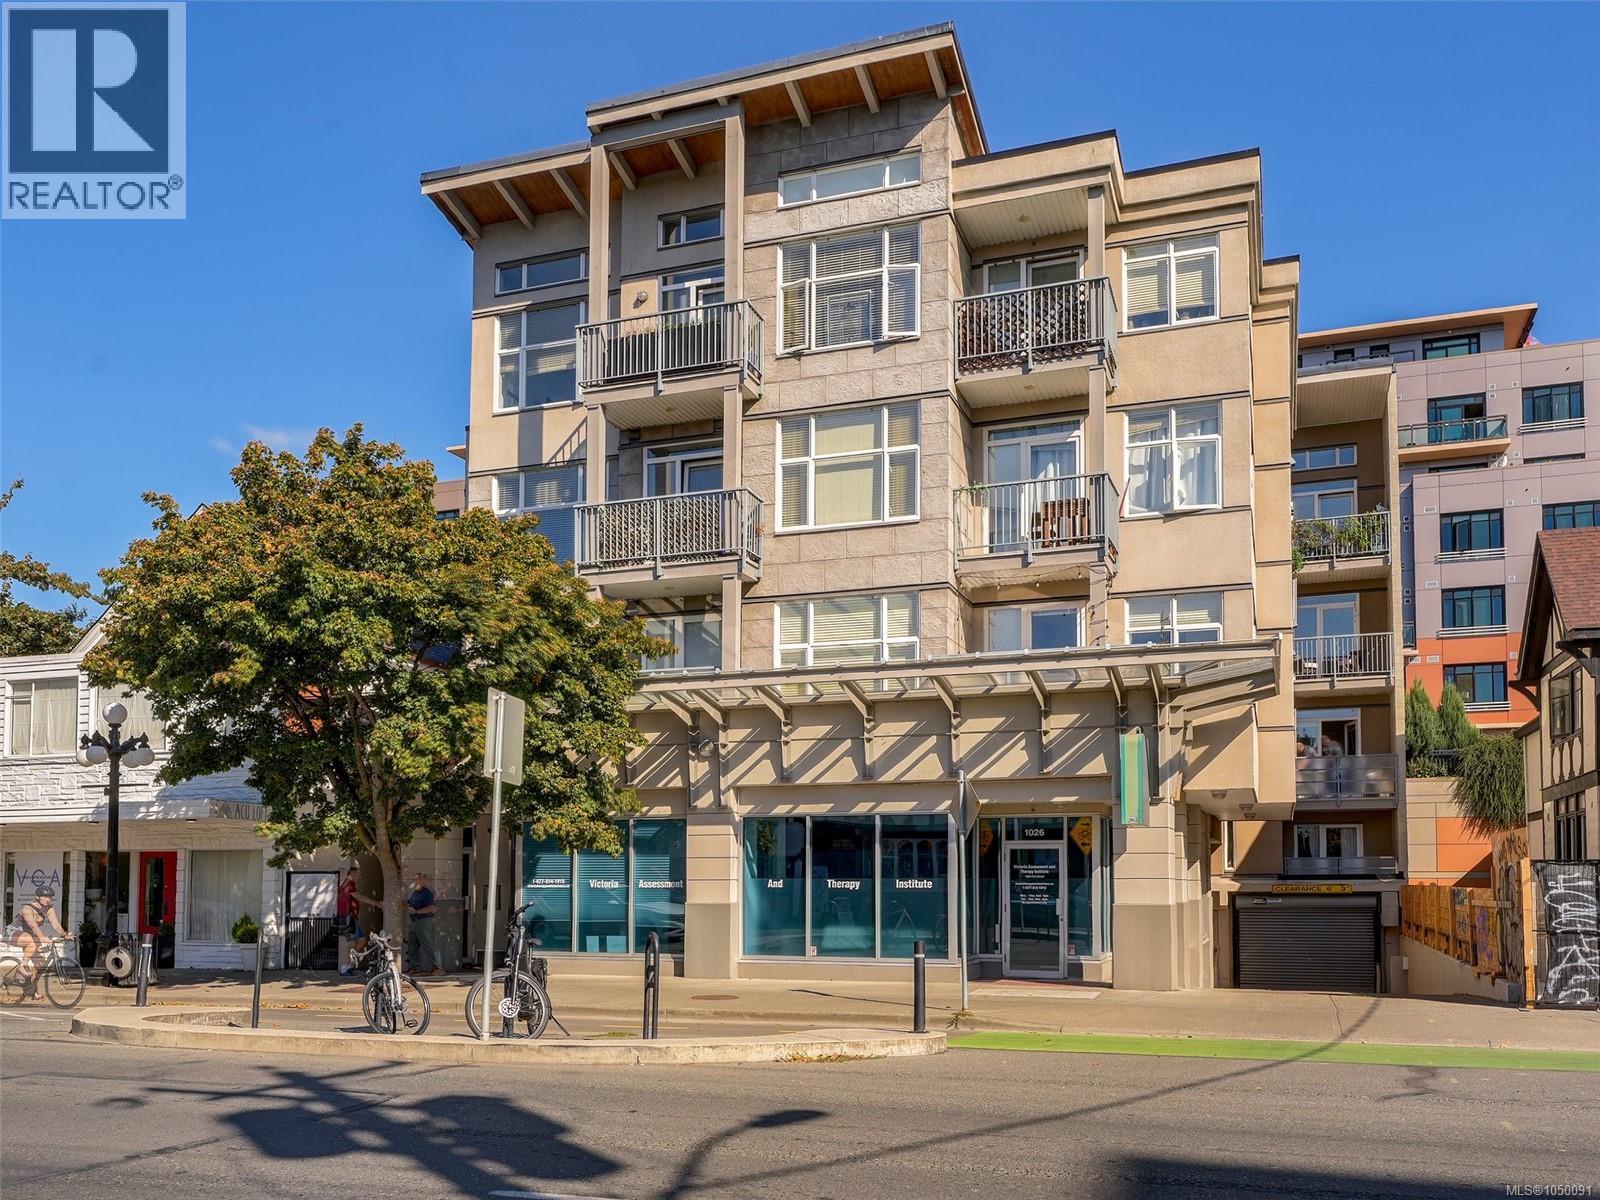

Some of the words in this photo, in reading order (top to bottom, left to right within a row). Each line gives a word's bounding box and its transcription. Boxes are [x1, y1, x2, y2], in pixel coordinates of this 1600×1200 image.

[234, 804, 250, 820] ACU
[1024, 828, 1045, 837] 1026
[15, 869, 61, 888] VCA
[589, 879, 619, 888] Victoria
[638, 879, 684, 889] Assessment
[767, 879, 784, 888] And
[826, 879, 861, 890] Therapy
[895, 879, 933, 889] Institute
[1275, 885, 1321, 893] CLEARANCE
